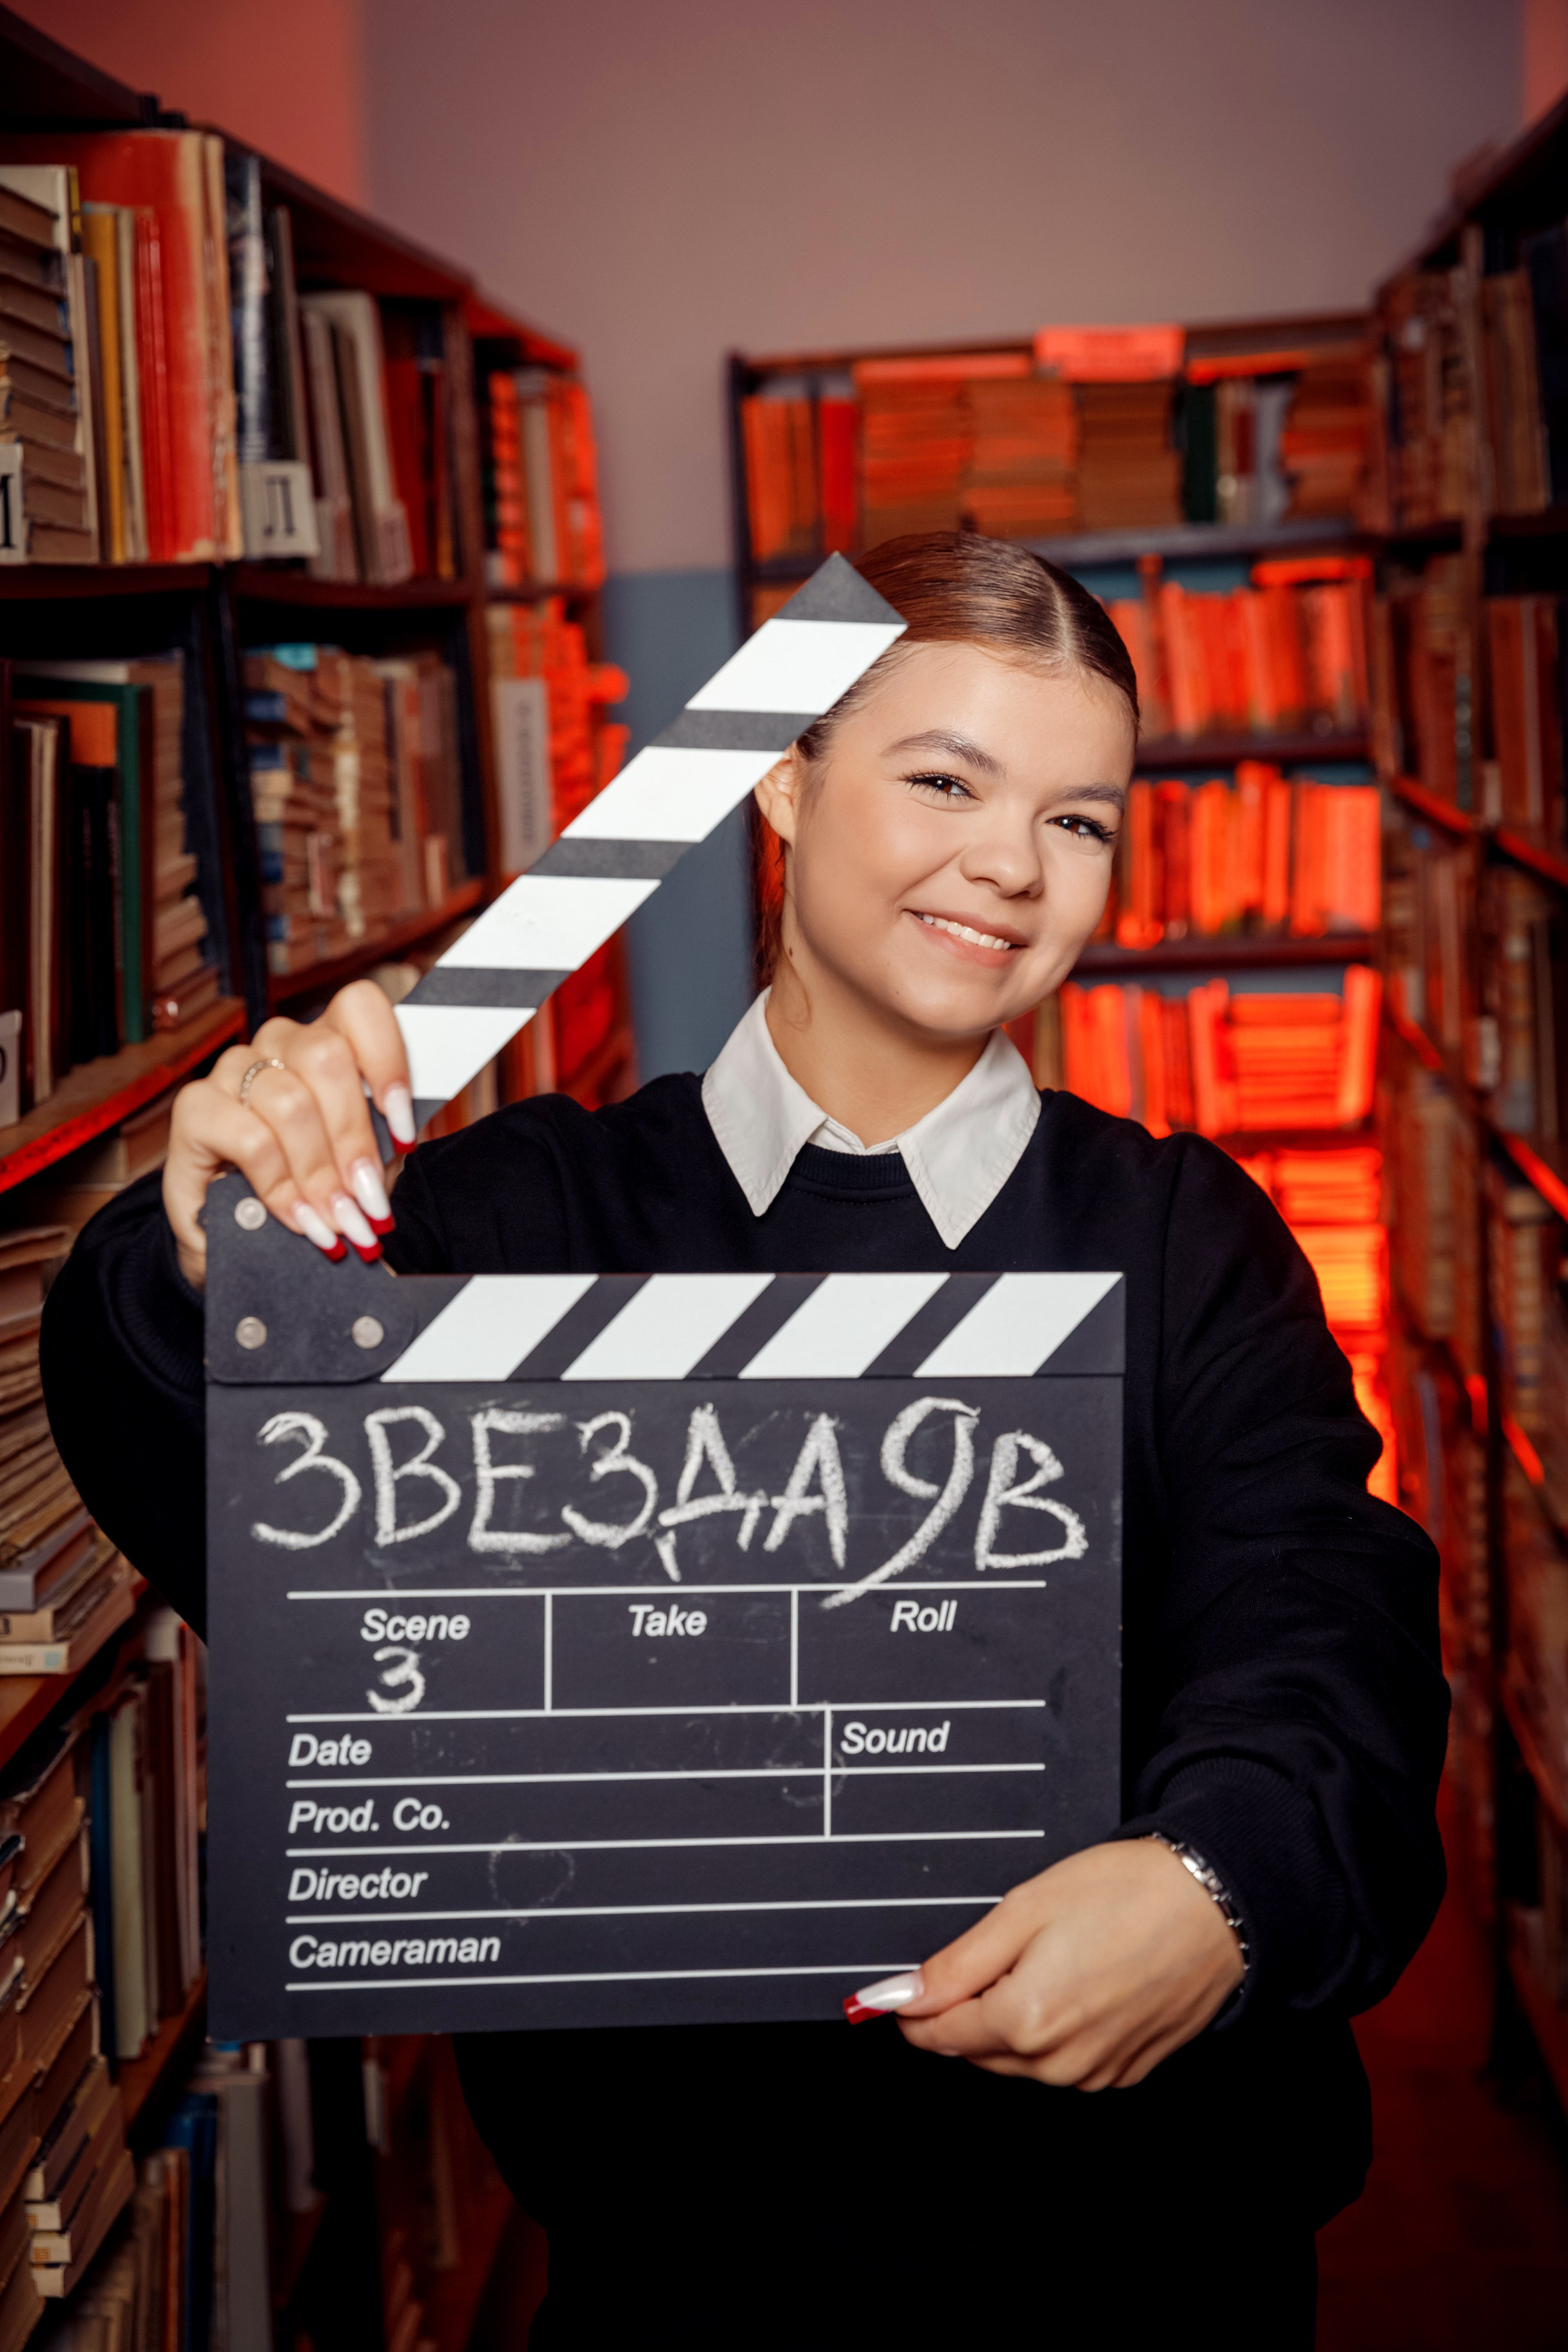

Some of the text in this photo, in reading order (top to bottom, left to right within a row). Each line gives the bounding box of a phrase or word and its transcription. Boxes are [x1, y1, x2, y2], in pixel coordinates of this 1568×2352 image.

[360, 1607, 471, 1643] Scene
[628, 1604, 709, 1638] Take
[889, 1599, 958, 1633] Roll
[367, 1645, 426, 1713] 3
[288, 1733, 373, 1767] Date
[840, 1720, 951, 1755] Sound
[288, 1797, 450, 1834] Prod. Co.
[288, 1867, 429, 1902] Director
[289, 1934, 501, 1968] Cameraman
